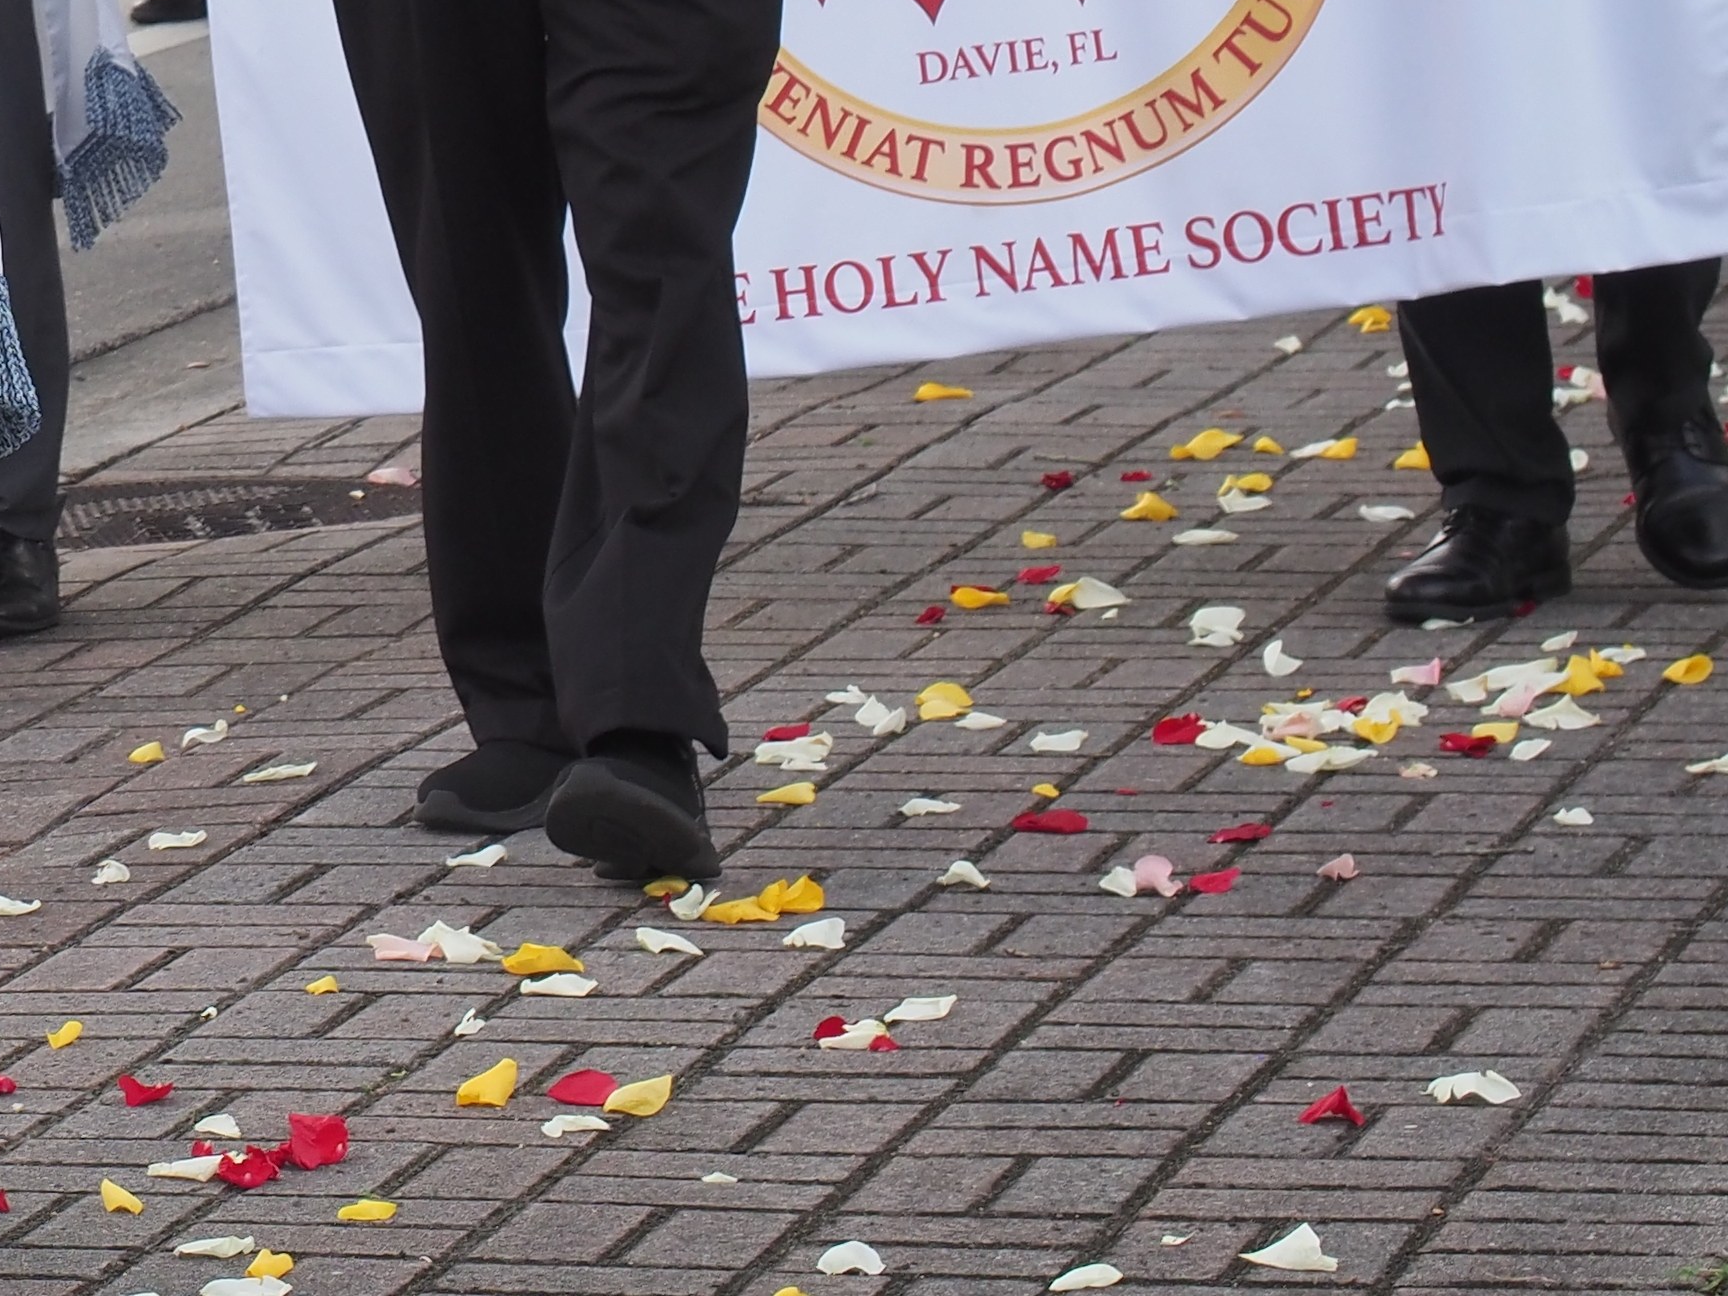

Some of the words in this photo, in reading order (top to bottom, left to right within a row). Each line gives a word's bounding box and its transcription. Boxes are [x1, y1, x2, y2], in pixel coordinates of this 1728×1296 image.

[916, 36, 1058, 85] DAVIE,
[1067, 28, 1118, 65] FL
[959, 68, 1226, 189] REGNUM
[769, 248, 952, 321] HOLY
[969, 221, 1170, 297] NAME
[1184, 182, 1447, 269] SOCIETY
